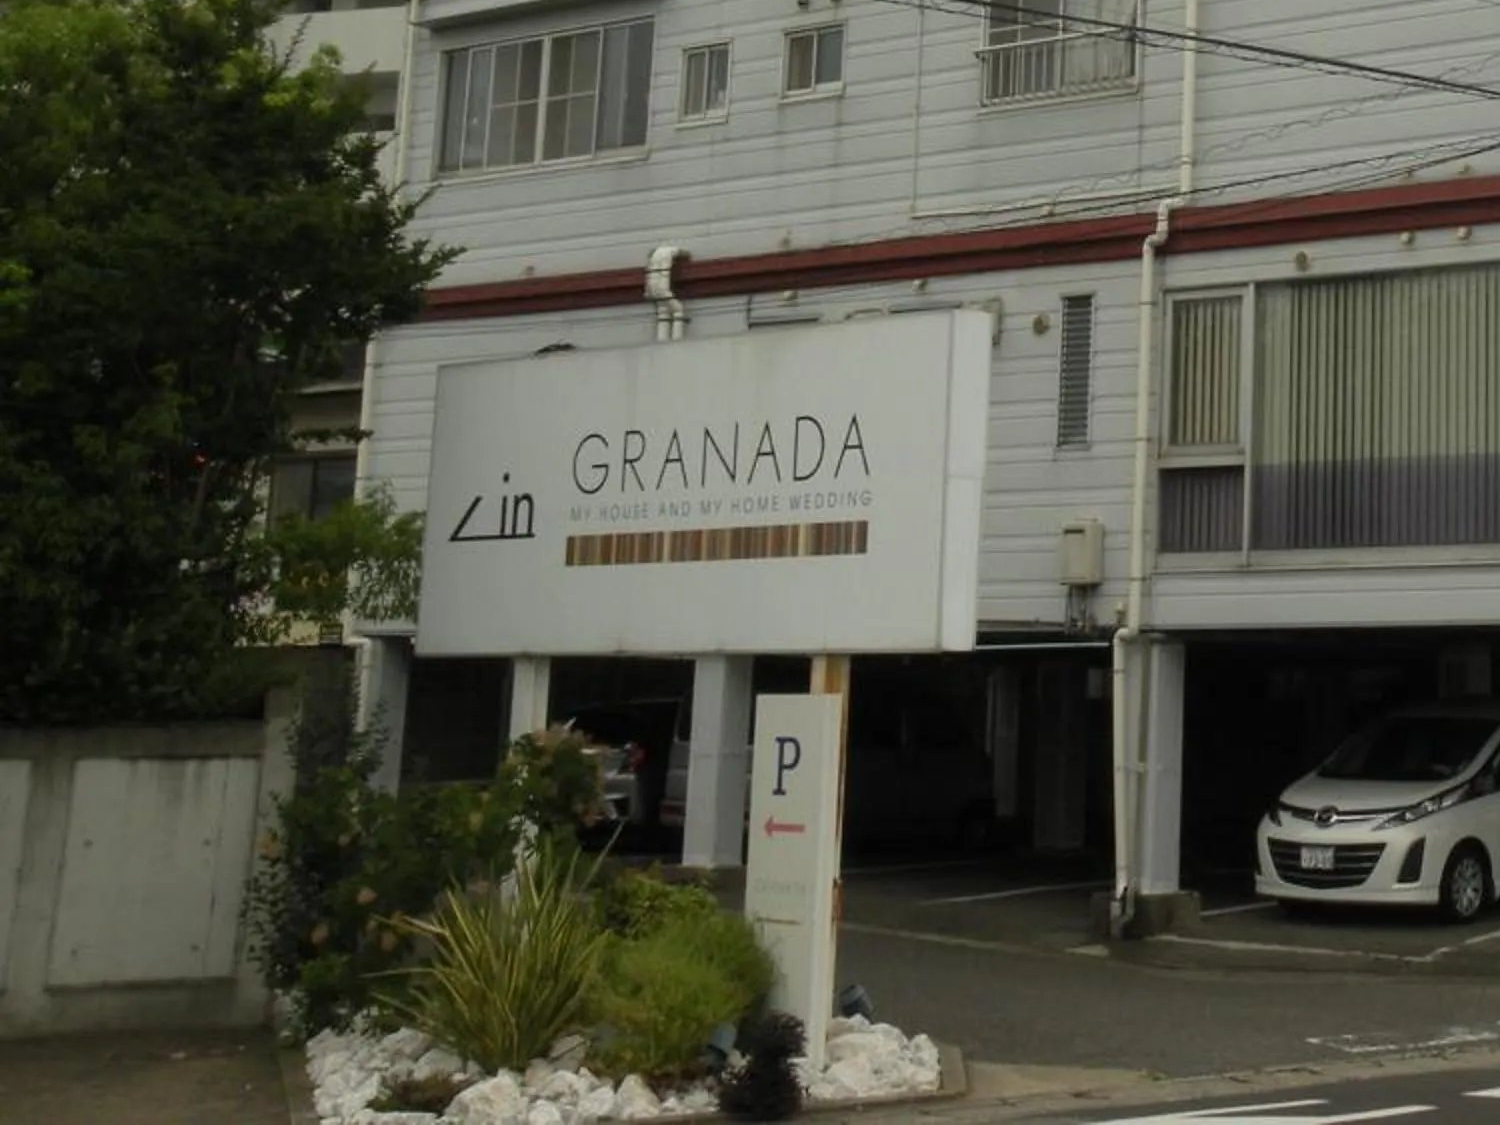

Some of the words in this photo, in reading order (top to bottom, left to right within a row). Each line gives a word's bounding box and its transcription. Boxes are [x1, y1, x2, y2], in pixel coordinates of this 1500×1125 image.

[572, 413, 871, 495] GRANADA
[569, 506, 591, 523] MY
[600, 504, 649, 523] HOUSE
[657, 501, 692, 518] AND
[701, 499, 723, 516] MY
[730, 495, 780, 515] HOME
[788, 490, 873, 511] WEDDING
[772, 736, 801, 796] P
